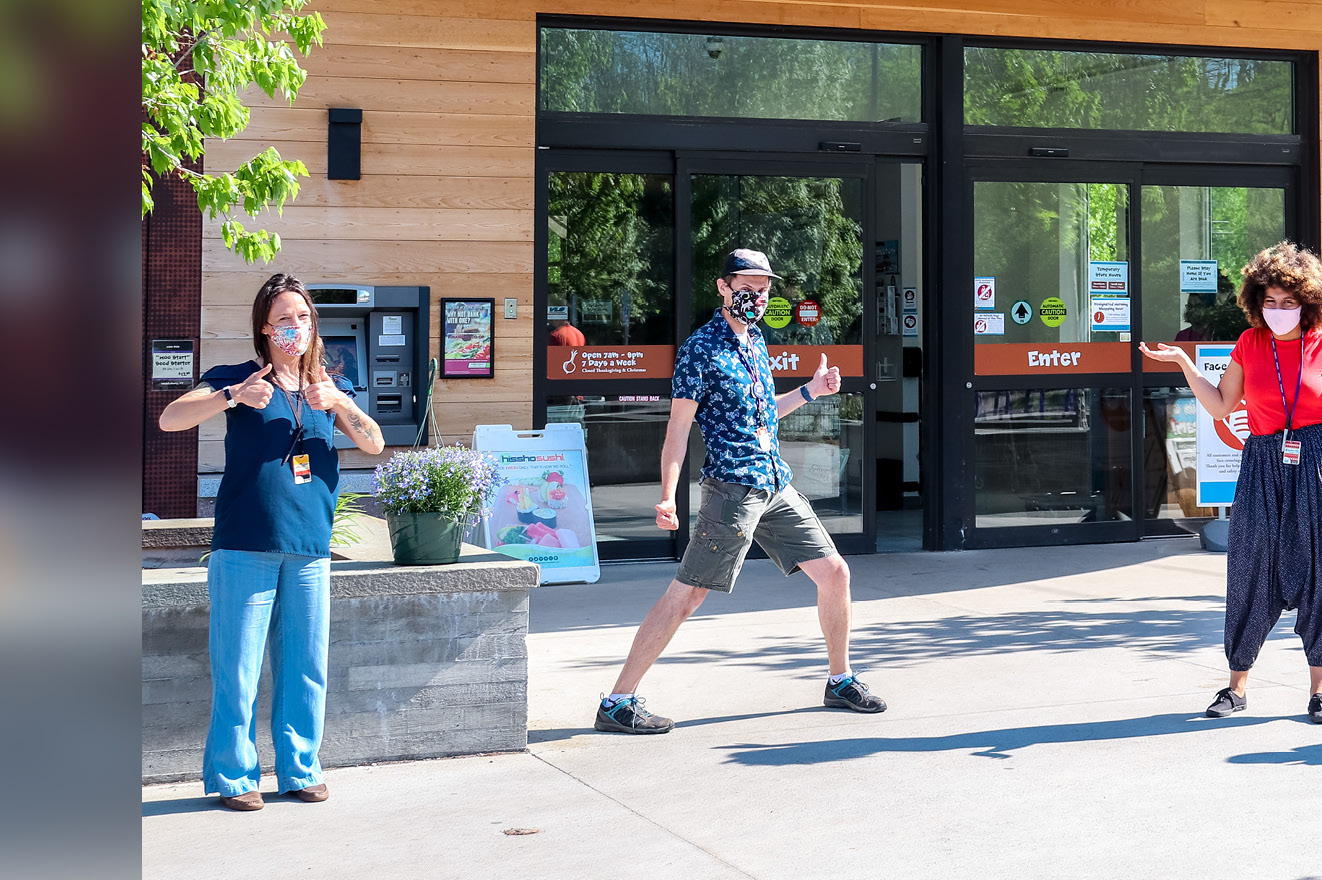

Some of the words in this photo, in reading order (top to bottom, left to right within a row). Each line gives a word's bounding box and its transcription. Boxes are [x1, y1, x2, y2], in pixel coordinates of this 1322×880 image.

[582, 352, 602, 360] Open
[1027, 350, 1081, 367] Enter
[588, 360, 608, 368] Days
[769, 351, 800, 371] xit
[1204, 363, 1227, 371] Face
